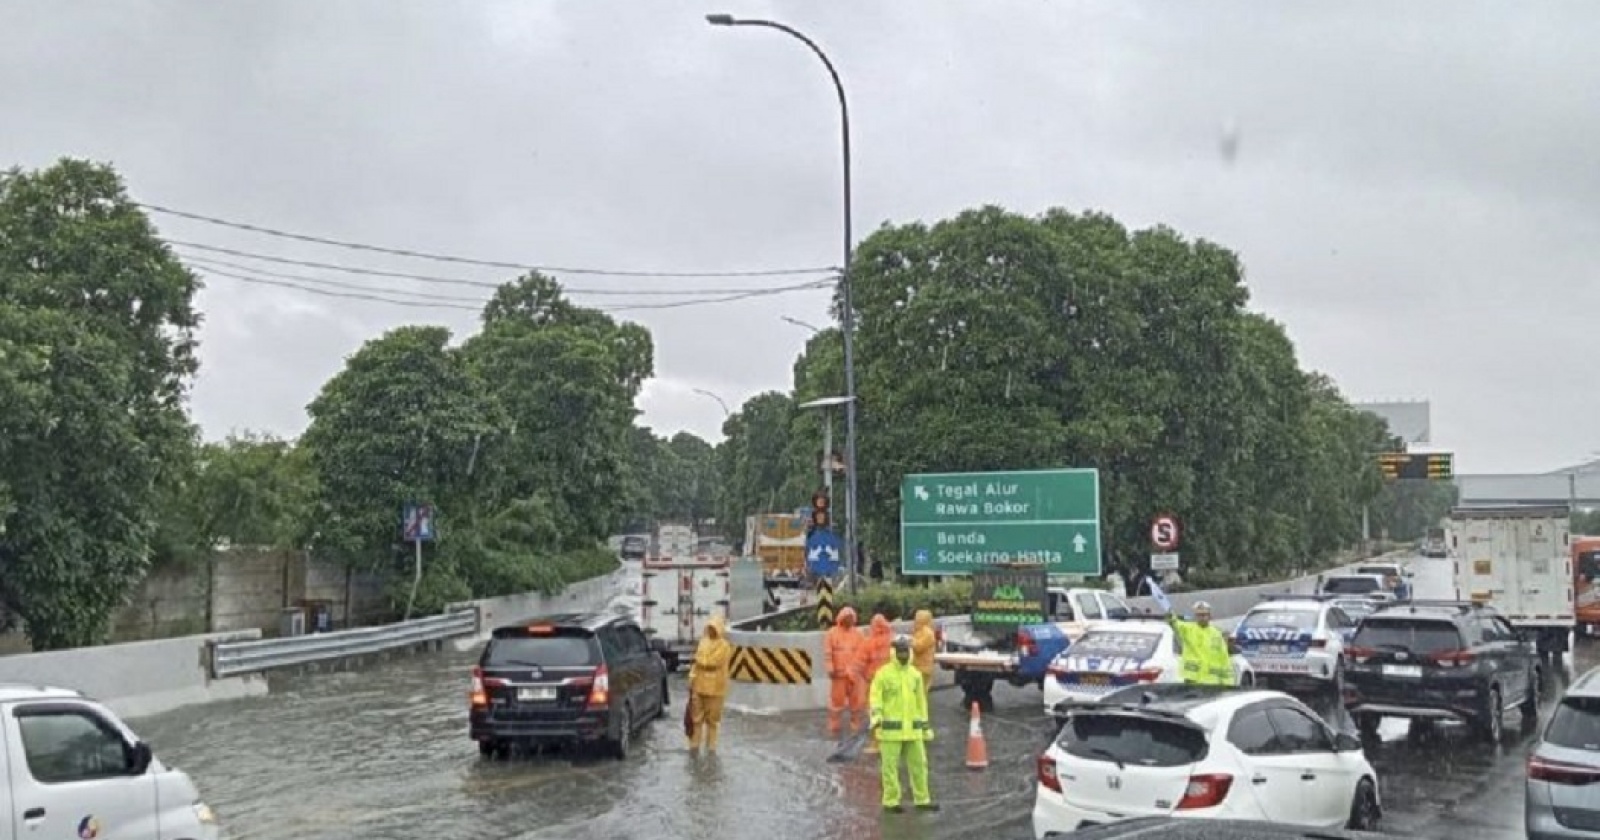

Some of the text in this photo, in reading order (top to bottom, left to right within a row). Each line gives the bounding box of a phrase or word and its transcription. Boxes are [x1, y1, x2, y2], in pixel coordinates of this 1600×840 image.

[936, 481, 1019, 500] Tegal Alur
[936, 500, 1030, 515] Rawa Bokor
[937, 531, 986, 545] Benda
[937, 549, 1062, 564] Soekarno-Hatta
